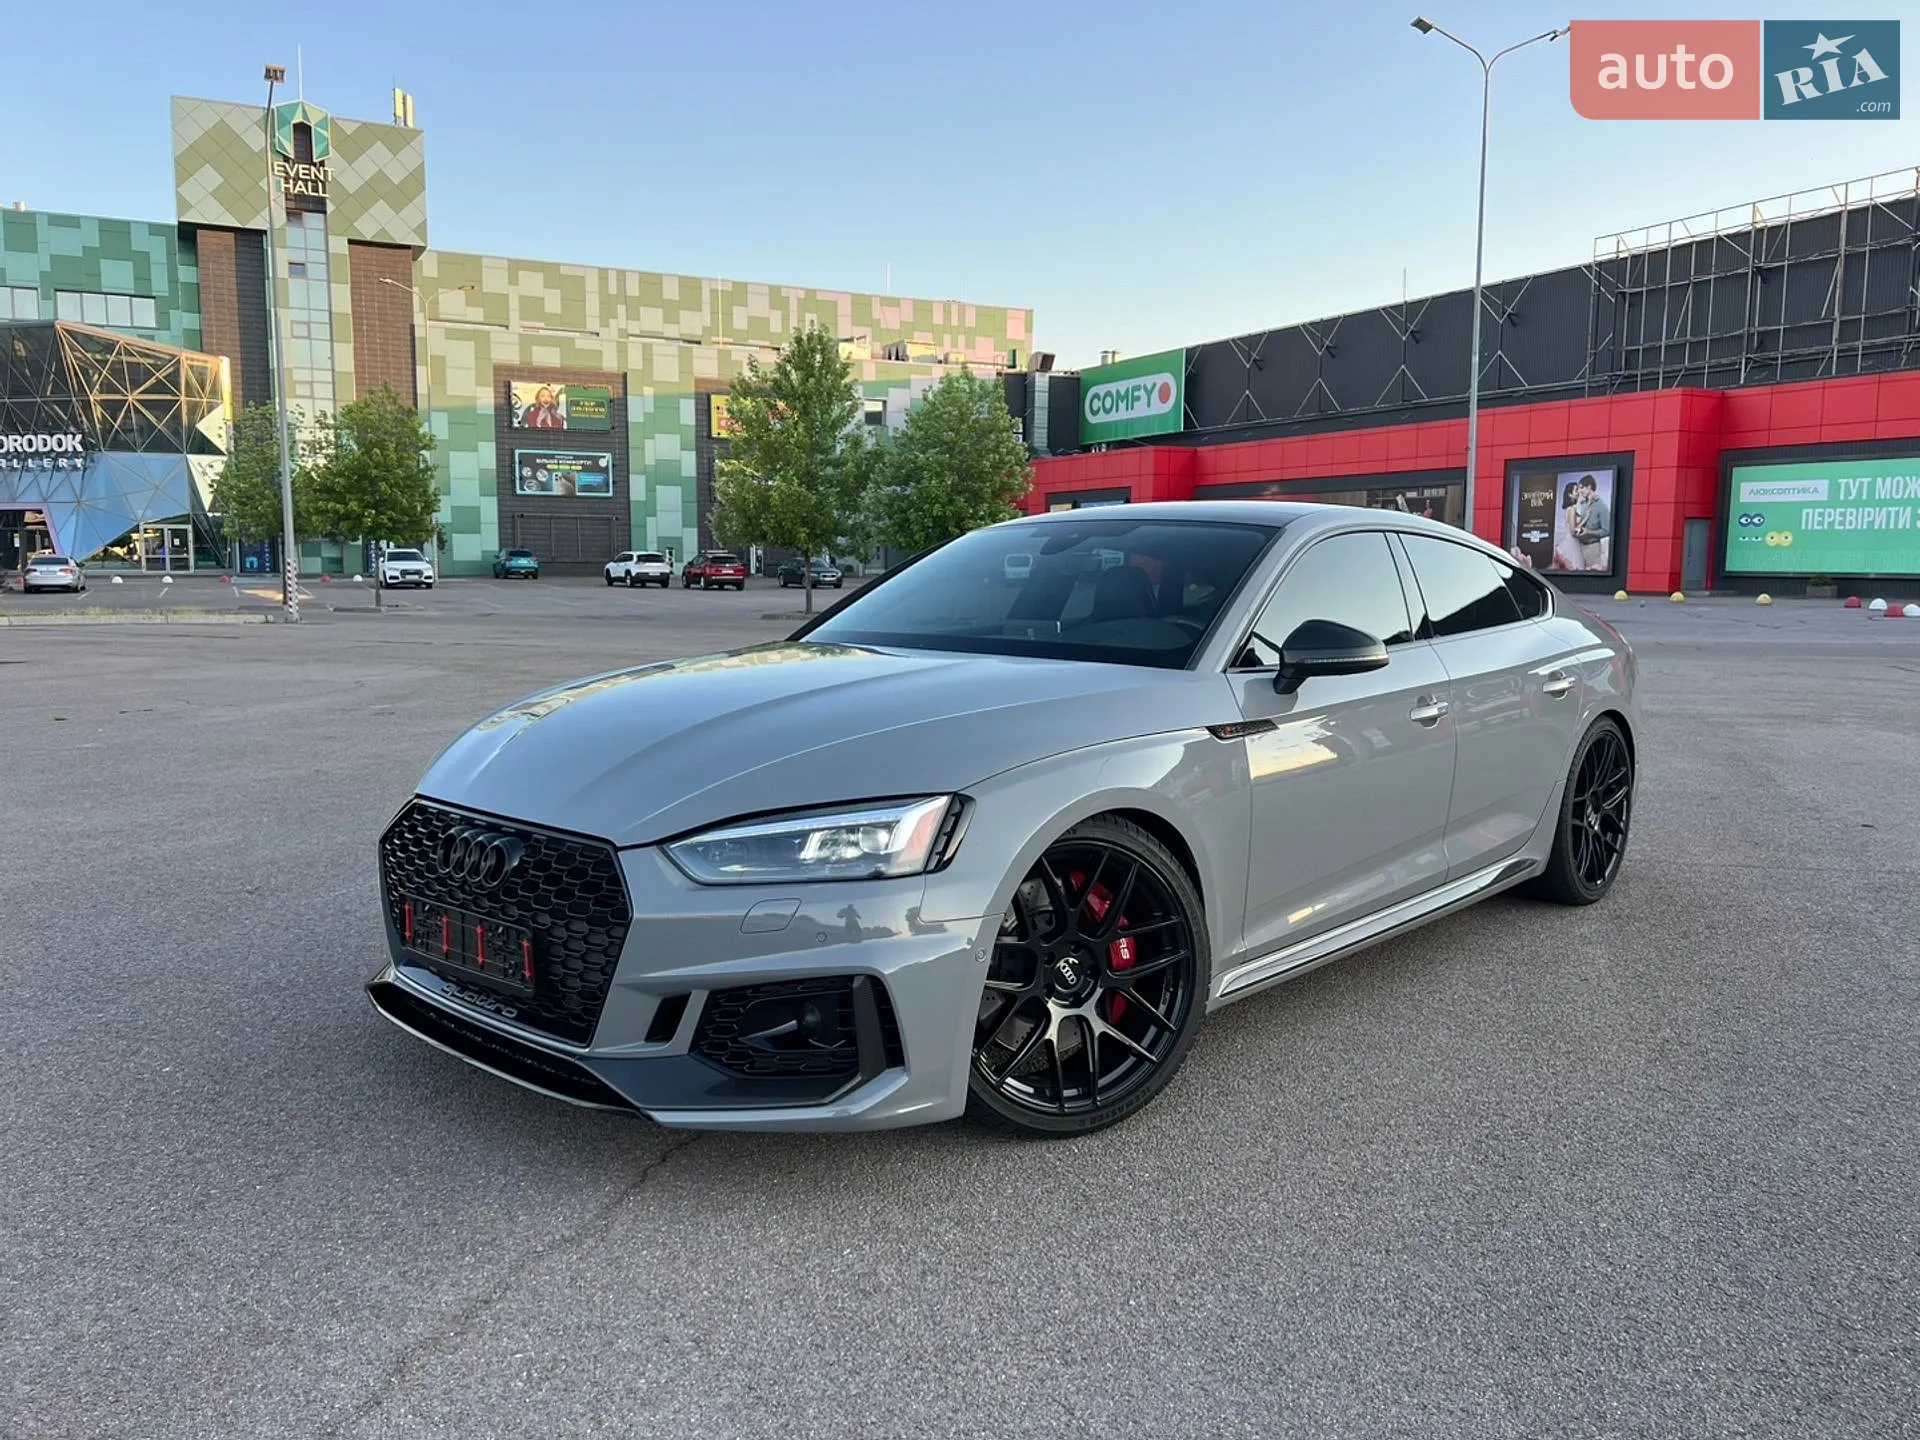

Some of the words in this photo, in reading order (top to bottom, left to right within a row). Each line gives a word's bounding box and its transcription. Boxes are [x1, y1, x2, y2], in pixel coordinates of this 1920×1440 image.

[273, 161, 335, 182] EVENT
[280, 178, 330, 197] HALL
[1088, 381, 1157, 417] COMFY
[1748, 486, 1819, 496] ЛЮКСОПТИКА
[1838, 477, 1872, 501] ТУТ
[1874, 475, 1920, 500] МОЖ
[1800, 506, 1912, 531] ПЕРЕВІРИТИ
[443, 982, 518, 1018] quattro
